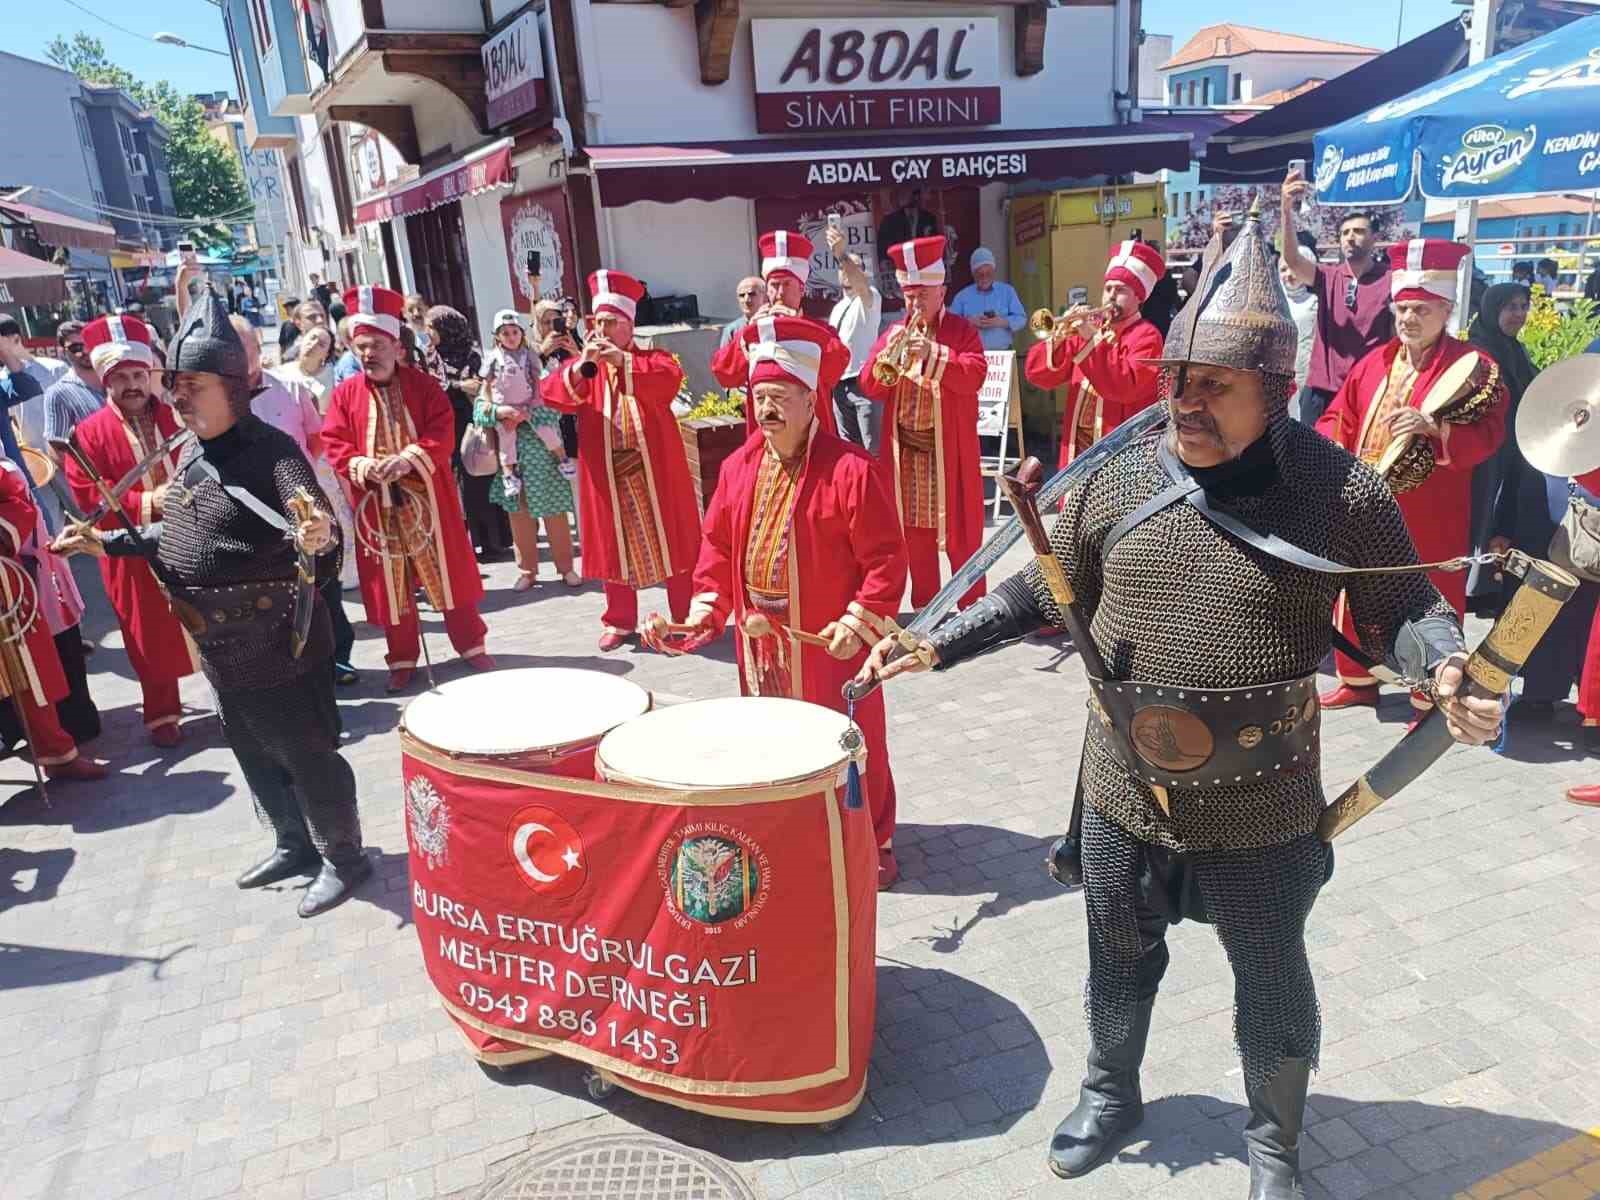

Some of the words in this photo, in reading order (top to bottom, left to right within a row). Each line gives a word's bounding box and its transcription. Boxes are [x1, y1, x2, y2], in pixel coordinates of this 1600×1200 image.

[779, 27, 973, 84] ABDAL
[786, 93, 877, 128] SİMİT
[890, 96, 979, 124] FIRINI
[807, 161, 881, 185] ABDAL
[891, 158, 932, 183] ÇAY
[1451, 138, 1523, 180] Ayran
[413, 879, 490, 935] BURSA
[497, 914, 758, 987] ERTUĞRULGAZİ
[439, 935, 556, 992] MEHTER
[565, 969, 709, 1029] DERNEĞİ
[459, 981, 529, 1023] 0543
[538, 1004, 598, 1037] 886
[607, 1020, 680, 1065] 1453
